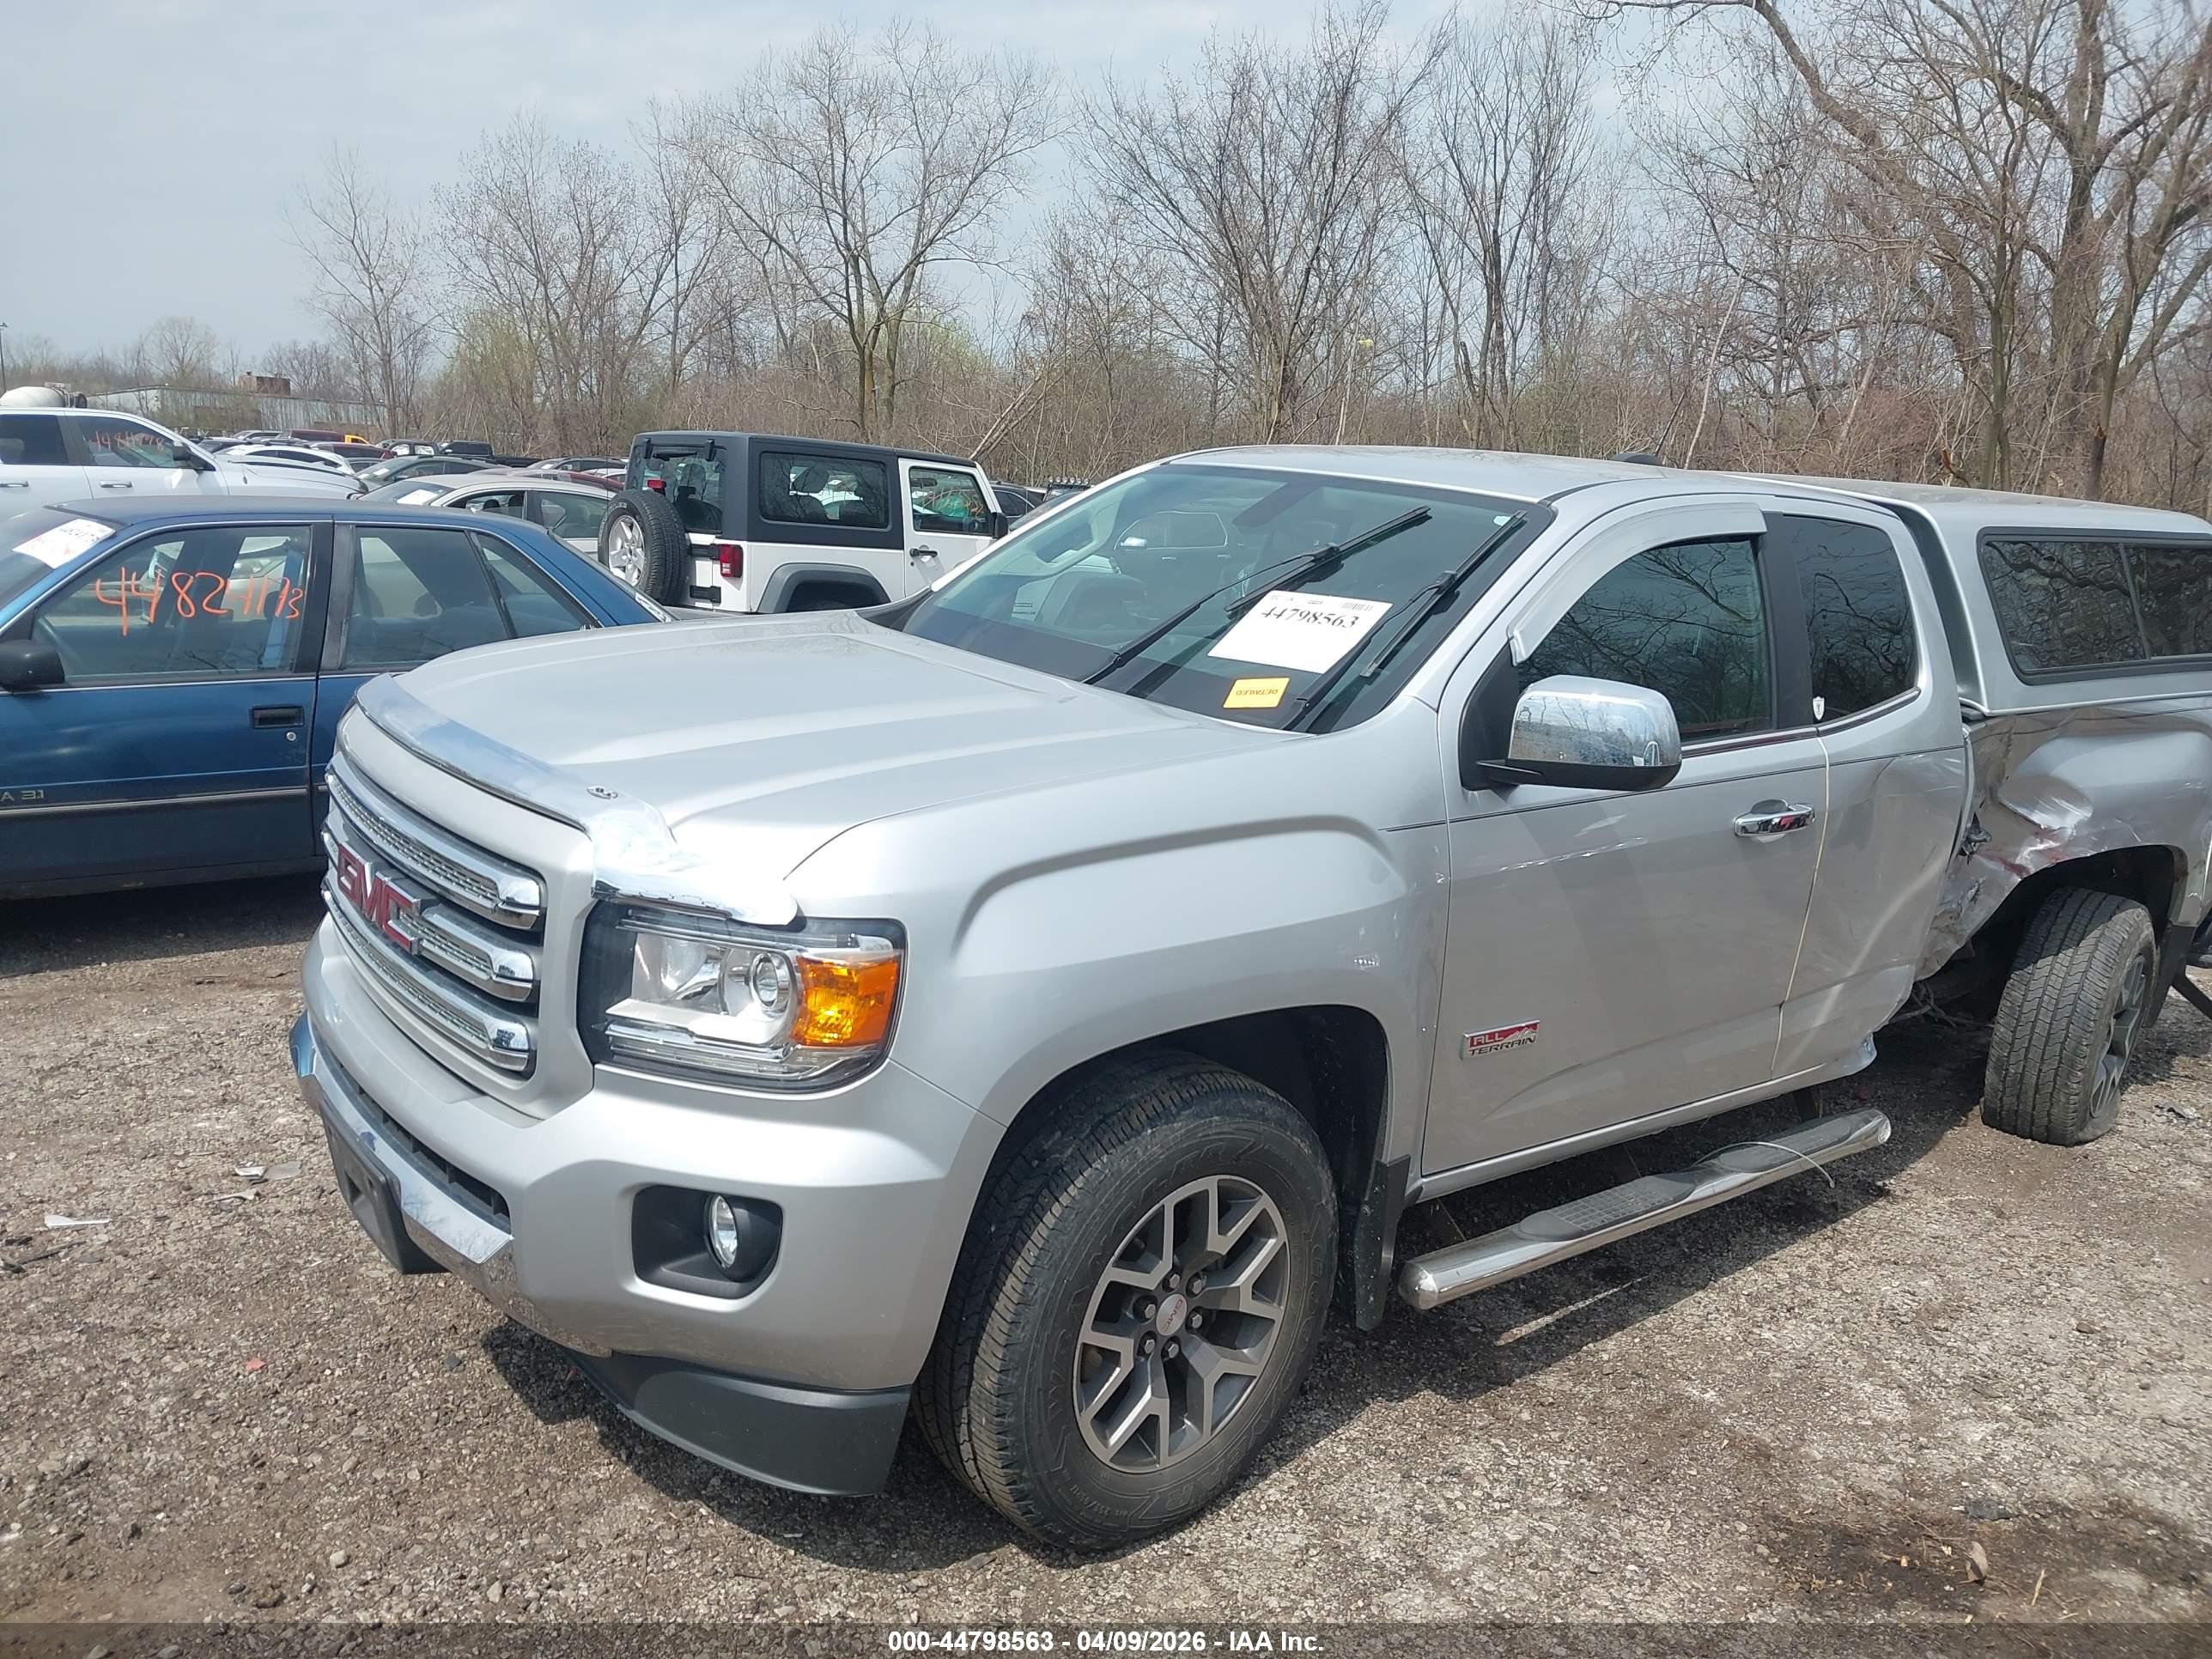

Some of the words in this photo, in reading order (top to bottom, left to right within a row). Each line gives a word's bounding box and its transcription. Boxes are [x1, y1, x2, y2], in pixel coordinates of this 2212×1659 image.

[1261, 605, 1360, 629] 44798563
[337, 842, 422, 955] GMC
[1469, 1035, 1537, 1057] TERRAIN
[1473, 1032, 1504, 1046] ALL
[1160, 1297, 1184, 1333] GMC
